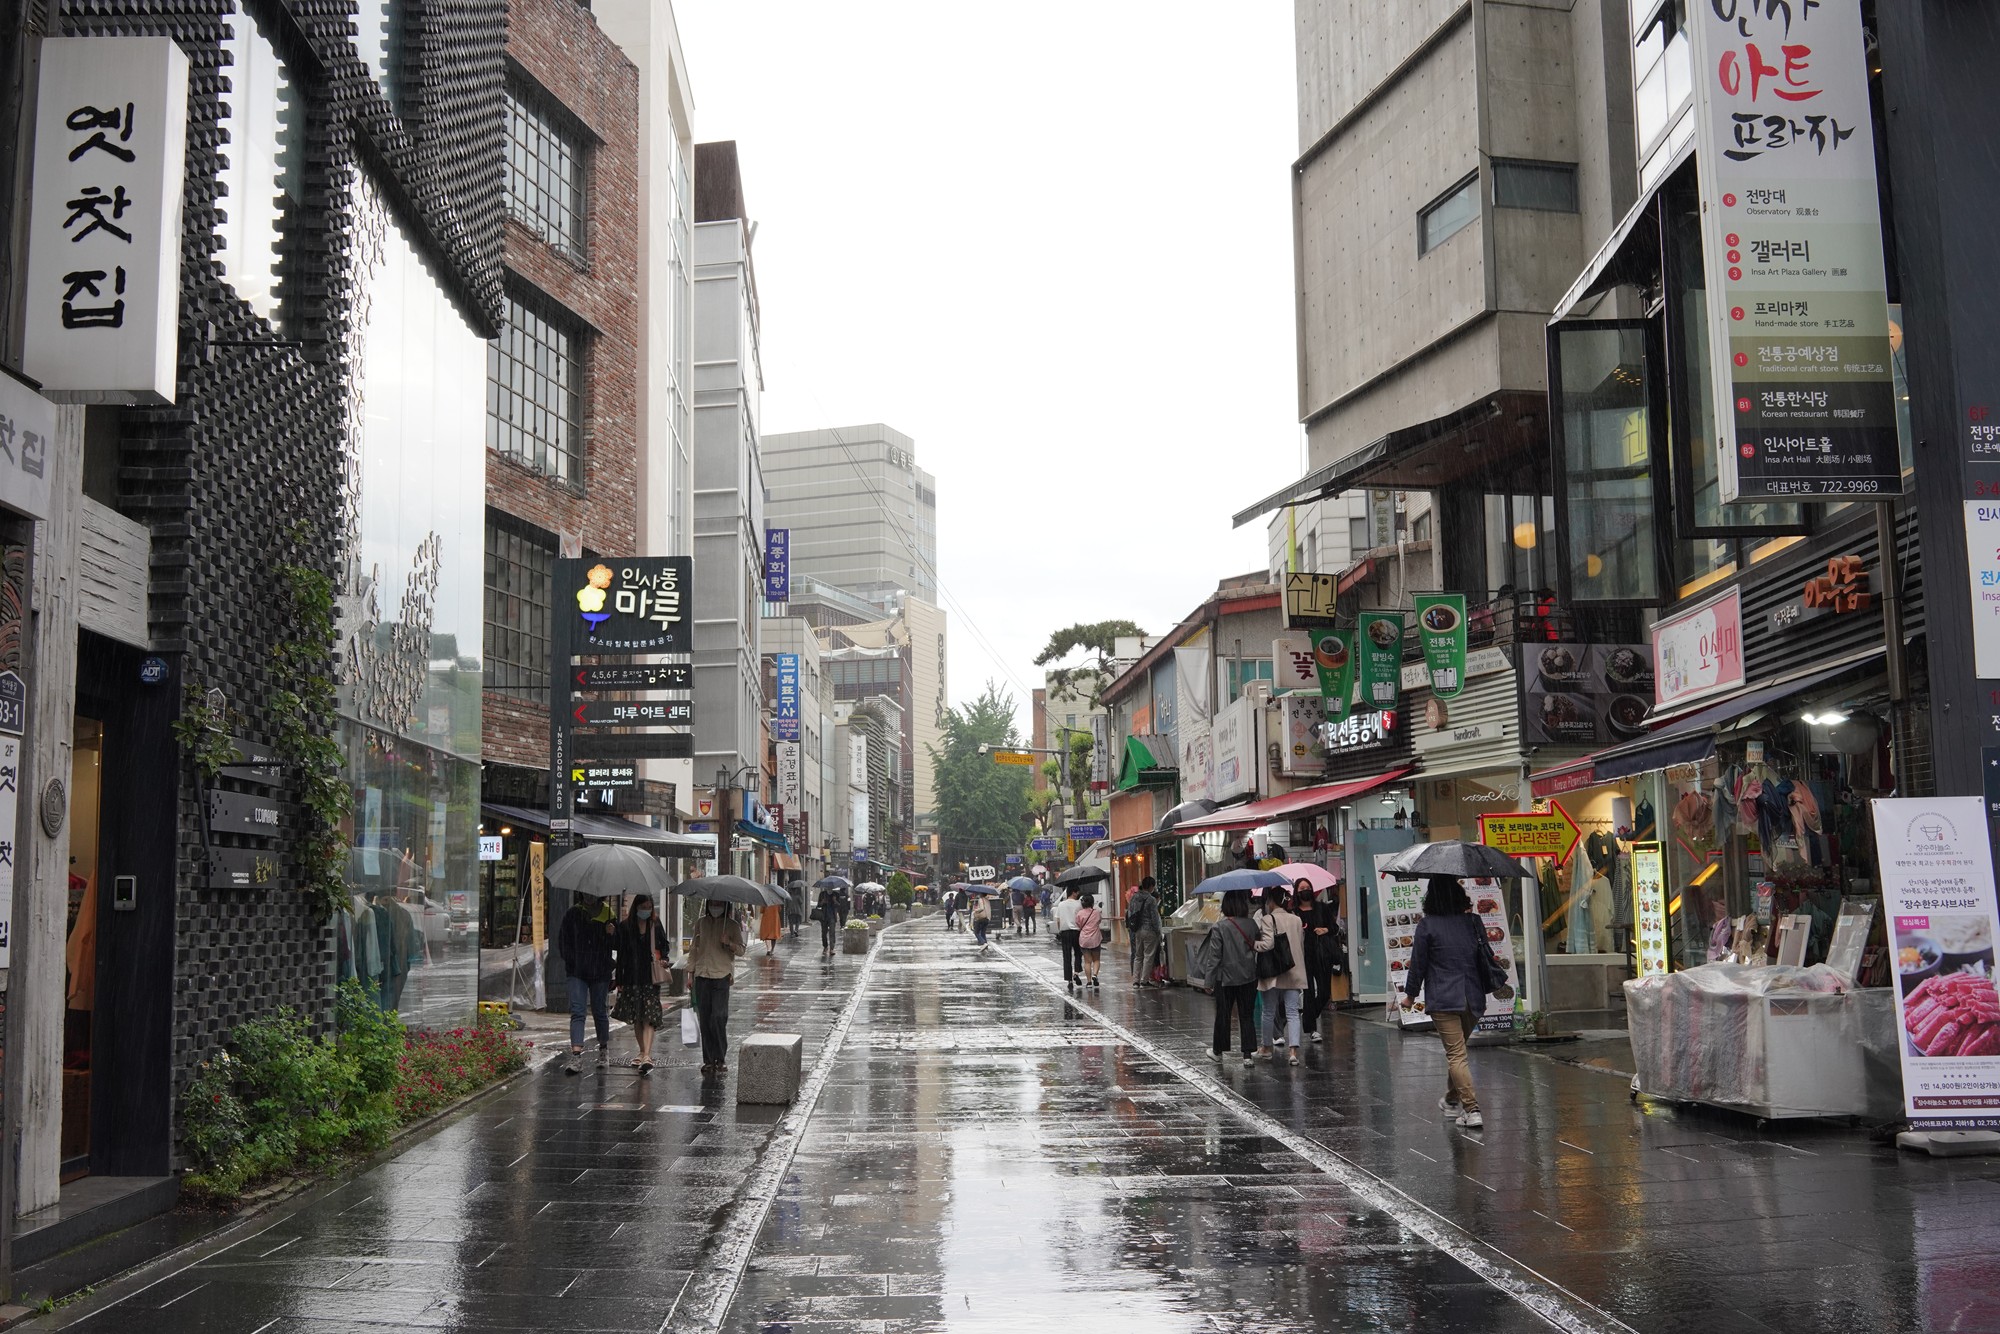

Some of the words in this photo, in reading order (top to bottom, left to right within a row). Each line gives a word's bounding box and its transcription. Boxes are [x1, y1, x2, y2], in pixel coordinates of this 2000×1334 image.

[1718, 43, 1823, 102] 아트
[1723, 112, 1856, 162] 프라자
[1746, 189, 1786, 205] 전망대
[61, 101, 136, 329] 옛찻집
[1746, 207, 1791, 216] Observatory
[1751, 240, 1810, 263] 갤러리
[1751, 268, 1766, 276] Insa
[1767, 268, 1780, 276] Art
[1781, 268, 1800, 276] Plaza
[1802, 268, 1828, 277] Gallery
[1754, 301, 1809, 317] 프리마켓
[1755, 320, 1798, 328] Hand-made
[1799, 320, 1819, 328] store
[1757, 346, 1839, 362] 전통공예상점
[1758, 364, 1798, 373] Traditional
[1799, 364, 1818, 373] craft
[1819, 365, 1839, 373] store
[1739, 401, 1749, 409] B1
[1761, 391, 1829, 408] 전통한식당
[1761, 410, 1788, 418] Korean
[1790, 410, 1828, 418] restaurant
[1968, 406, 1991, 421] 6F
[1743, 447, 1753, 455] B2
[1763, 436, 1833, 453] 인사아트홀
[1765, 456, 1780, 464] Insa
[1782, 456, 1795, 464] Art
[1796, 456, 1811, 464] Hall
[1766, 481, 1813, 494] 대표번호
[1820, 481, 1878, 493] 722-9969
[769, 531, 786, 589] 세종화랑
[621, 567, 679, 590] 인사동
[615, 589, 682, 631] 마루
[1429, 637, 1455, 647] 전통차
[1699, 620, 1738, 671] 오색미
[1371, 652, 1395, 662] 팥빙수
[141, 666, 161, 677] ADT
[591, 670, 618, 679] 4,5,6F
[644, 668, 687, 684] 김치간
[5, 745, 14, 757] 2F
[588, 768, 610, 777] 갤러리
[1489, 823, 1505, 832] 명동
[1509, 822, 1538, 831] 보리밥과
[1540, 822, 1565, 831] 코다리
[1496, 832, 1561, 845] 코다리전문
[1916, 844, 1951, 852] 장수하늘소
[1391, 884, 1421, 897] 팥빙수
[1386, 898, 1417, 911] 잘하는
[1920, 1082, 1930, 1090] 1인
[1955, 1119, 1976, 1127] 지하1층
